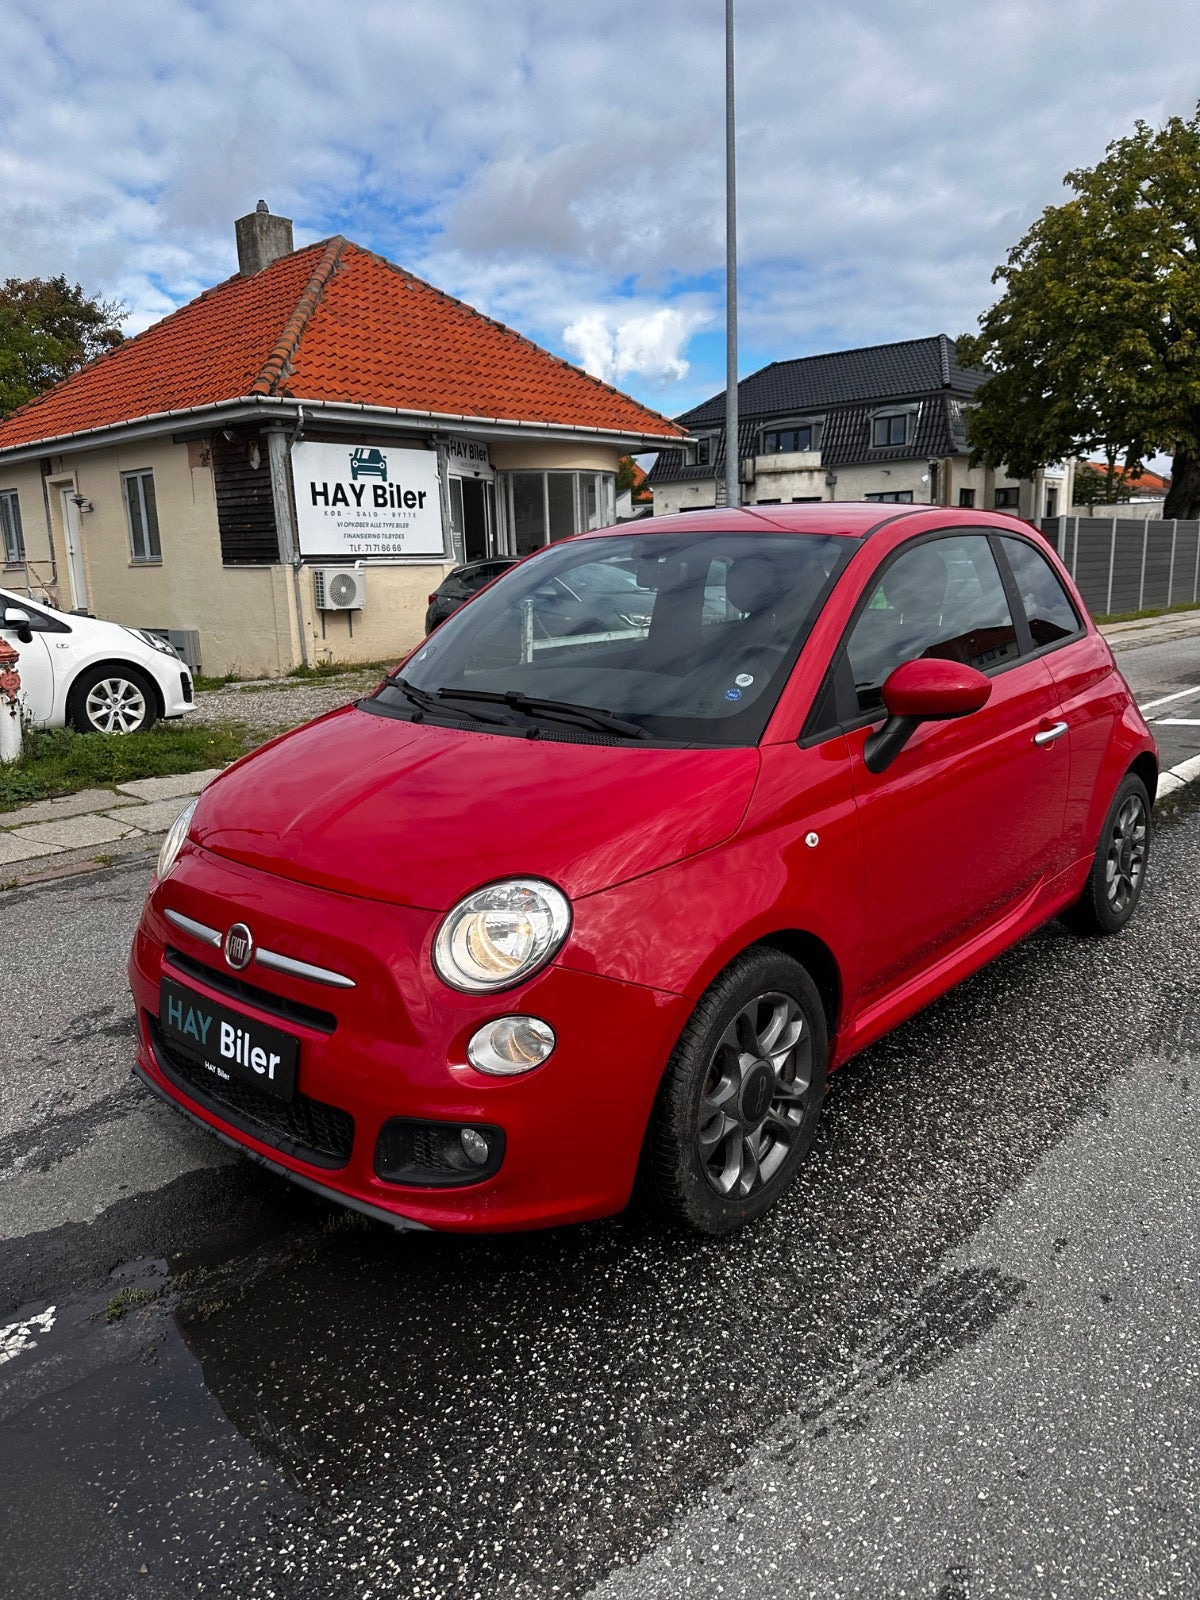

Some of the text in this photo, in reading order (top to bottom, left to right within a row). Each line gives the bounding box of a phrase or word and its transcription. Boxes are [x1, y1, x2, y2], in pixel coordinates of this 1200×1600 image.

[450, 440, 486, 461] HAY Biler
[310, 481, 427, 509] HAY Biler
[349, 544, 365, 552] TLF.
[229, 935, 247, 960] FIAT
[168, 994, 280, 1080] HAY Biler
[204, 1060, 230, 1080] HAY Biler
